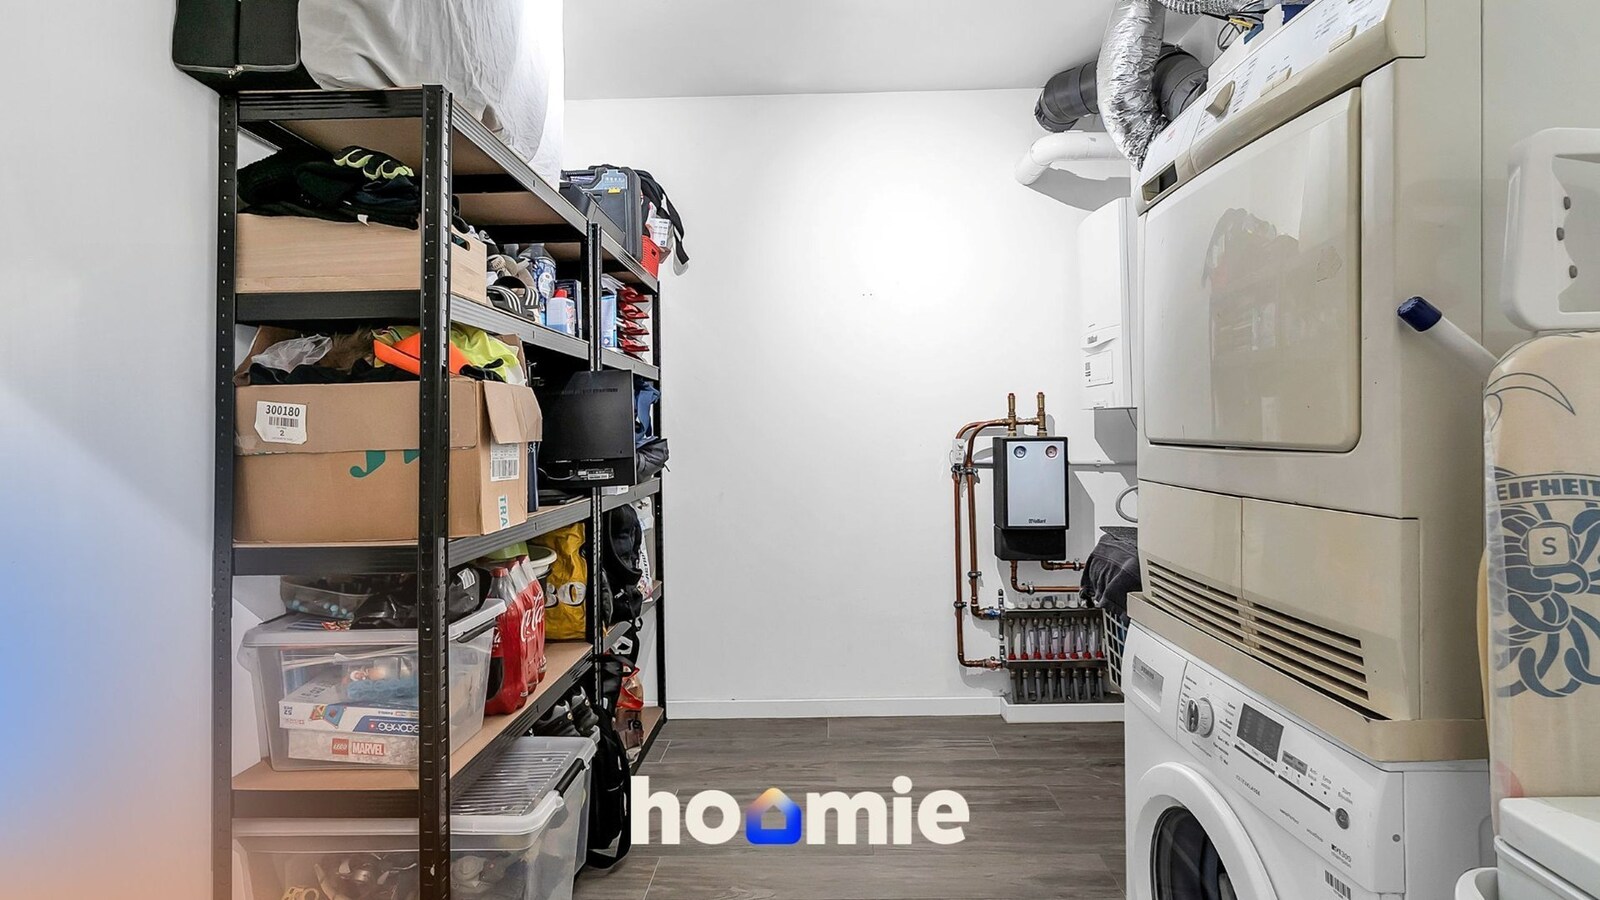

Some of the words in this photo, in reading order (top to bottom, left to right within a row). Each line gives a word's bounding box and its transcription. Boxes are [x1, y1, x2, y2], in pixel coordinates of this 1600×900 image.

[265, 405, 300, 417] 300180
[1542, 537, 1557, 555] S
[352, 742, 384, 756] MARVEL
